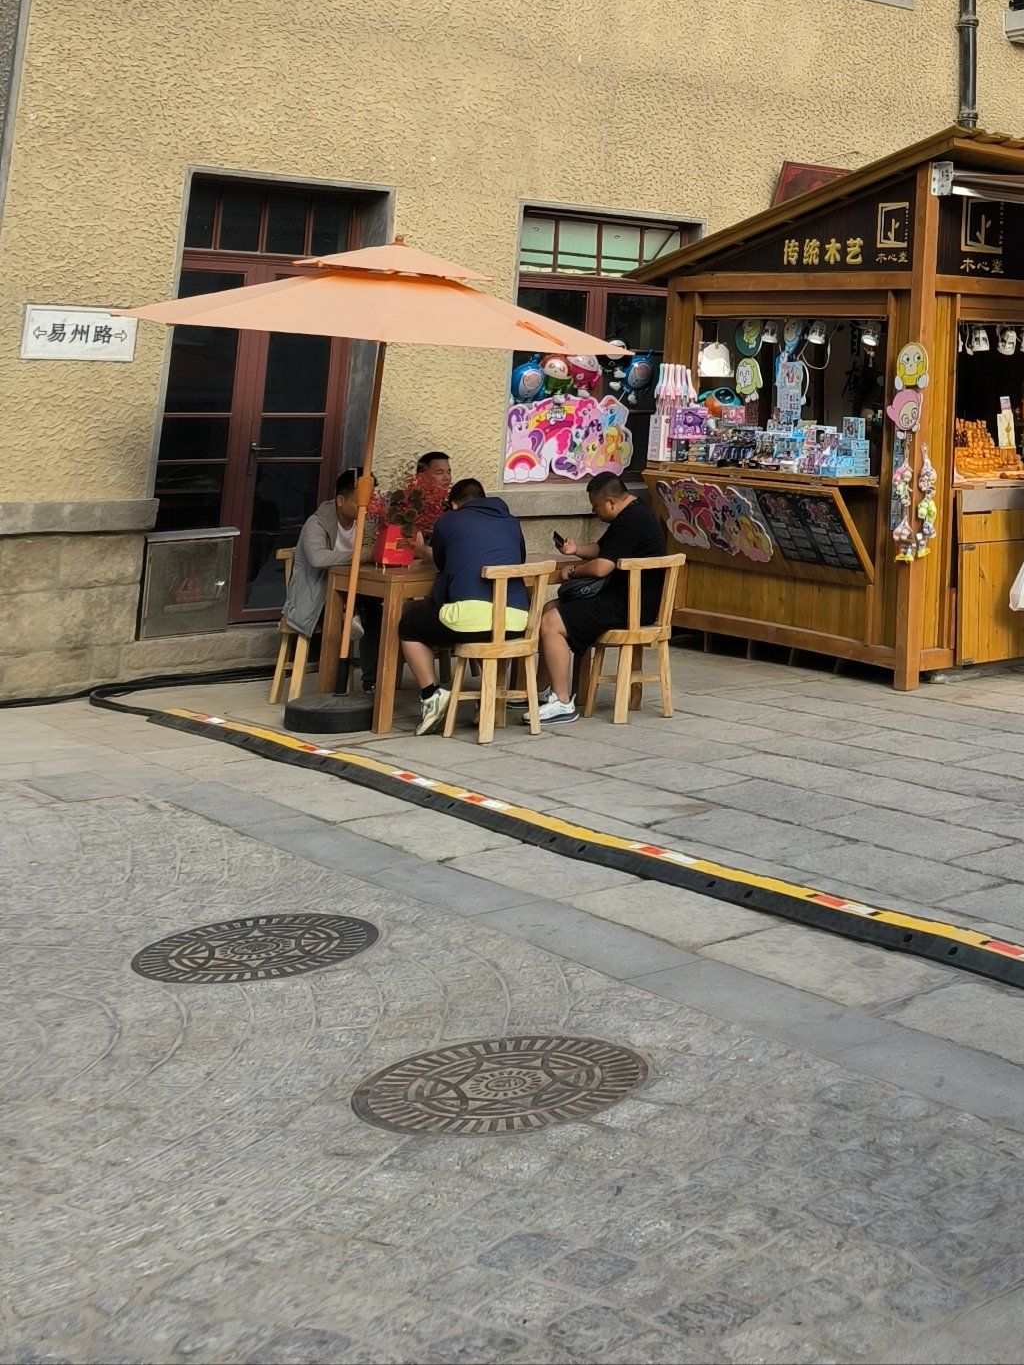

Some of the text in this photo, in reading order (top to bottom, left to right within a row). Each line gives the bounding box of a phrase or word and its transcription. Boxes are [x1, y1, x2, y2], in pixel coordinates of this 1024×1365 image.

[783, 237, 865, 266] 传统木艺
[875, 250, 908, 264] 木心堂
[959, 257, 1004, 274] 木心堂
[47, 322, 113, 344] 易州路
